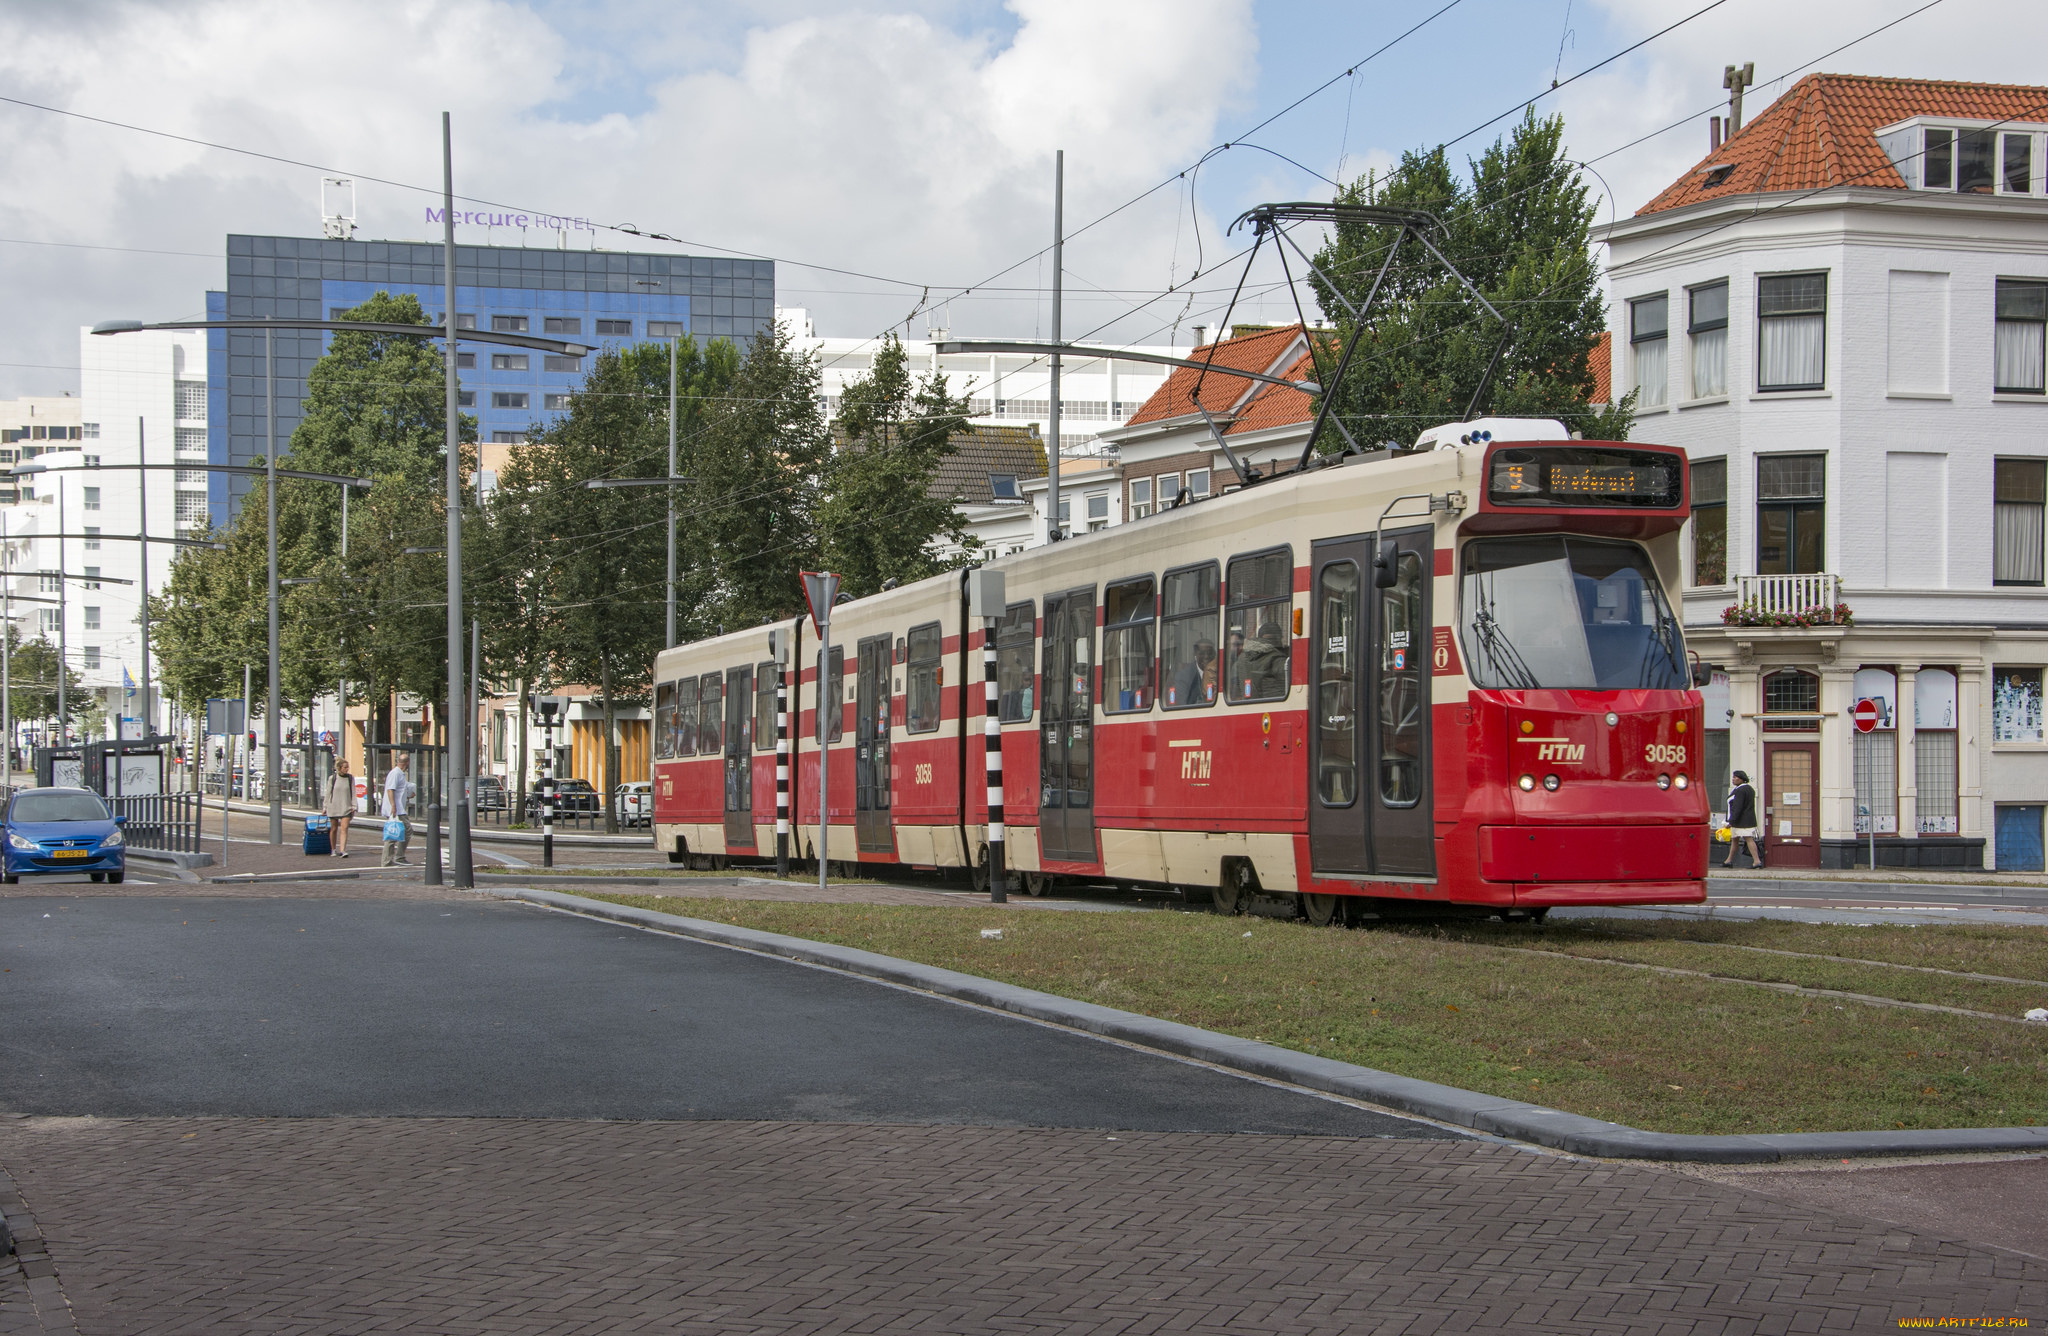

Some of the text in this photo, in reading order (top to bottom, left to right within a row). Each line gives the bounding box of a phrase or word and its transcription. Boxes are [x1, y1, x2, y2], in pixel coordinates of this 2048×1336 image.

[426, 207, 595, 231] Mercure HOTEL
[1538, 744, 1586, 761] HTM
[1645, 744, 1687, 764] 3058
[915, 763, 933, 785] 3058
[1181, 750, 1213, 779] HTM
